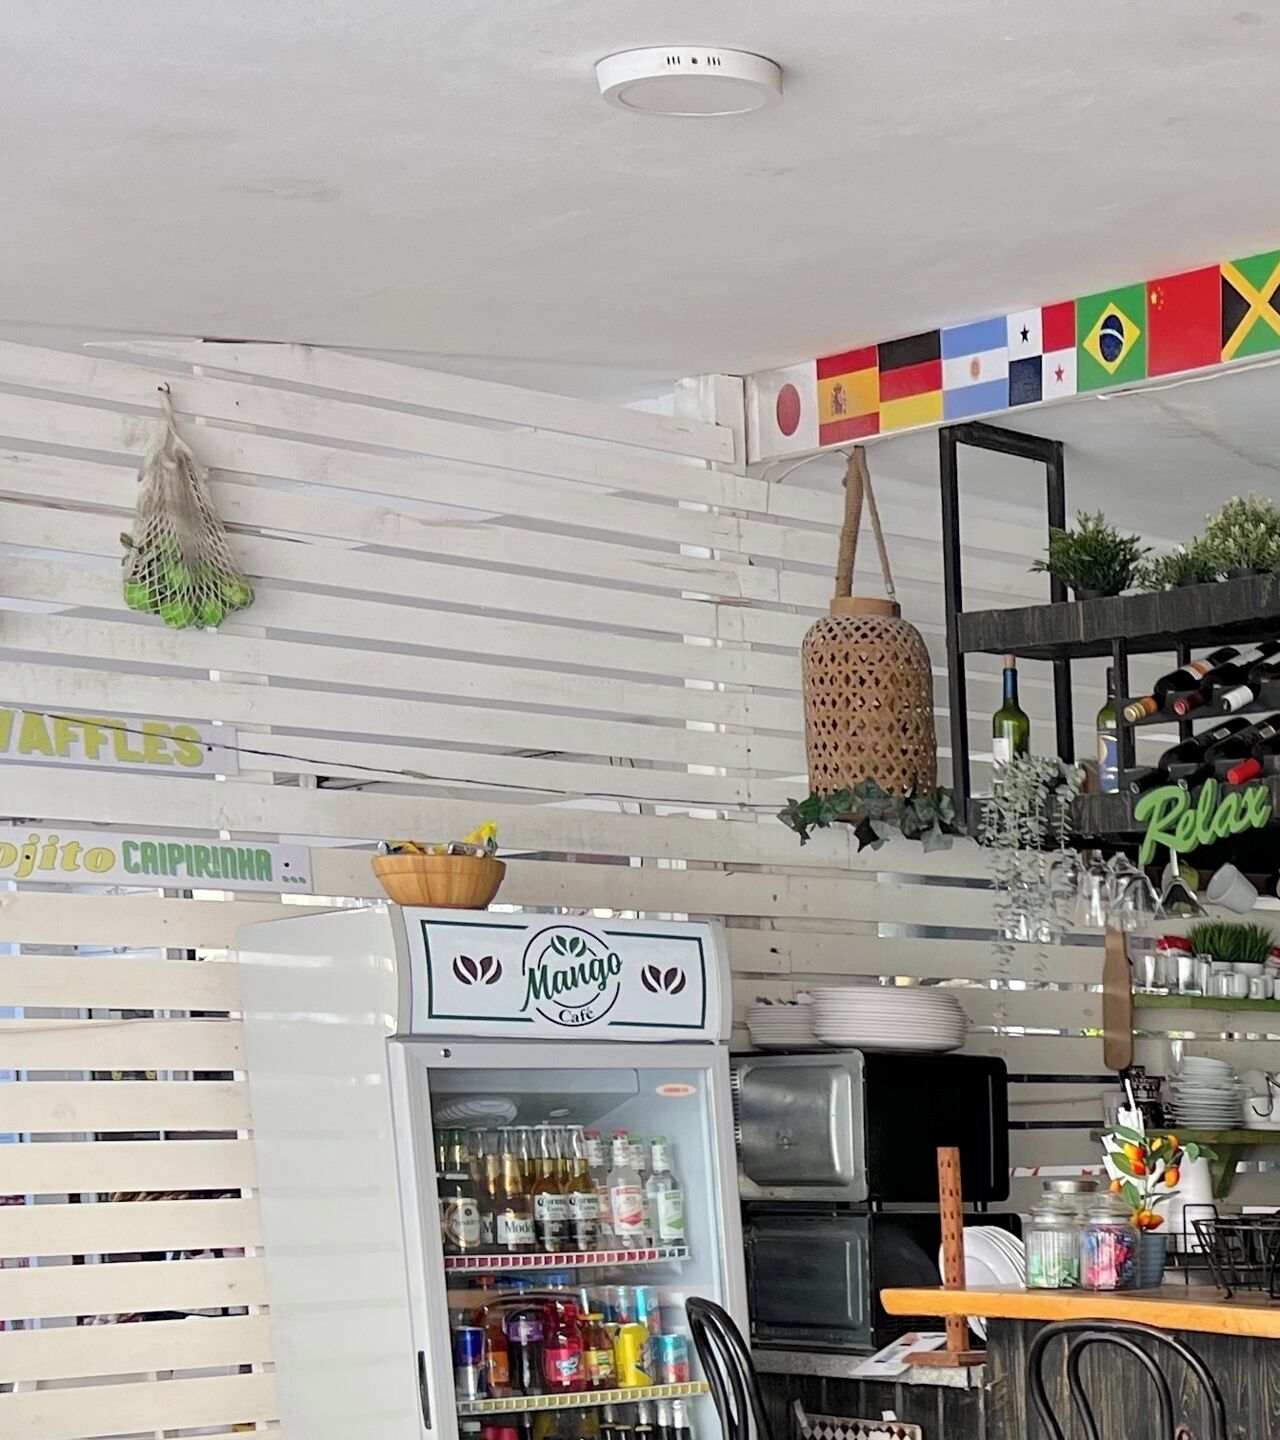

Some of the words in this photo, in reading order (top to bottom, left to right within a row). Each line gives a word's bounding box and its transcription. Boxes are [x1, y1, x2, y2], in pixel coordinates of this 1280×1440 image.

[1134, 777, 1272, 866] Relax
[122, 840, 273, 882] CAIPIRINHA
[520, 952, 623, 1012] Mango
[558, 1006, 595, 1024] Café
